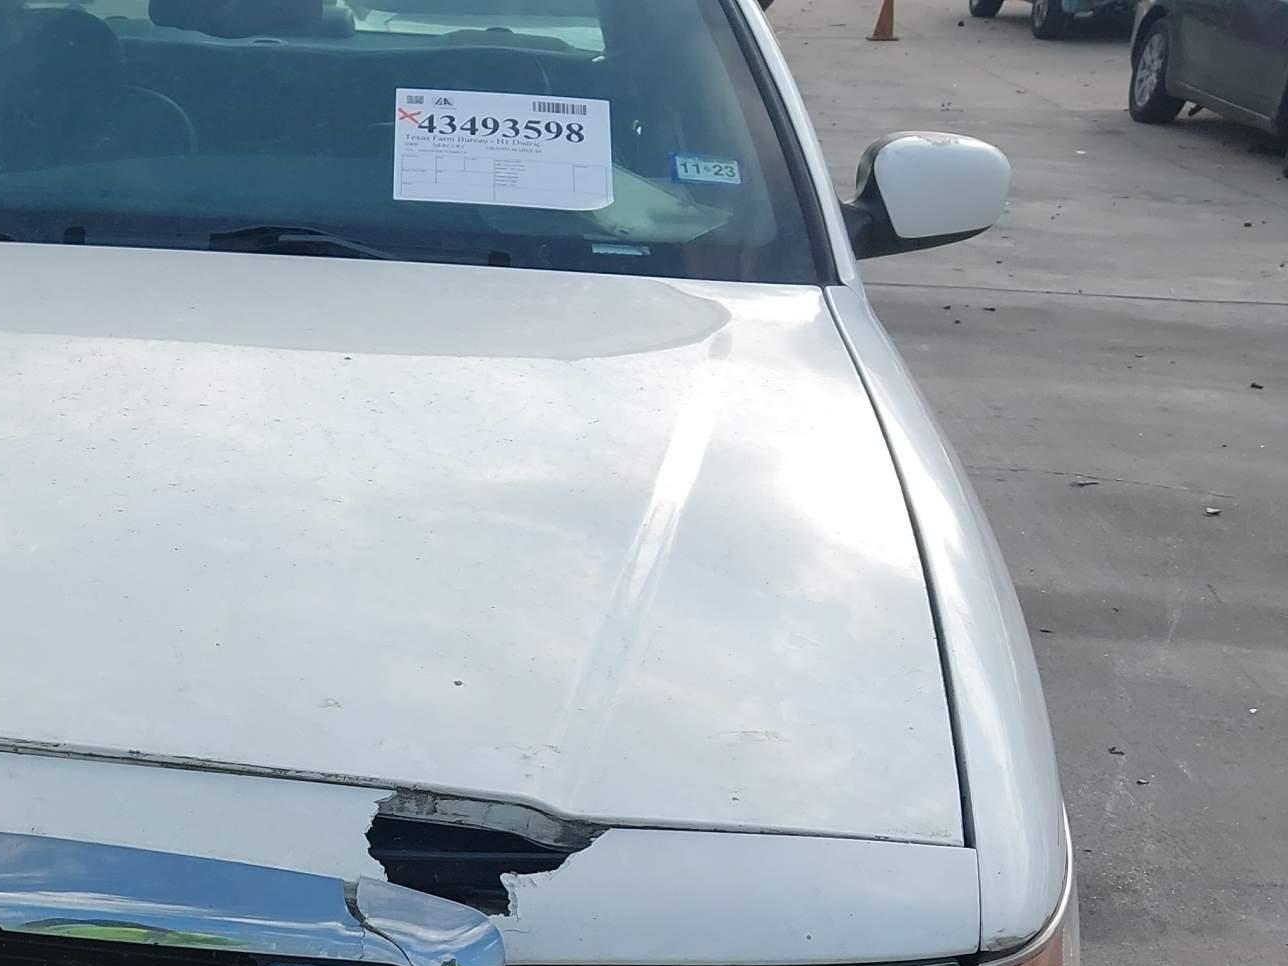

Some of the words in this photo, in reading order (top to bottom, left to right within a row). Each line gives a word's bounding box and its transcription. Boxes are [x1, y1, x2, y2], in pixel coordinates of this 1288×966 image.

[417, 113, 585, 143] 43493598
[406, 134, 430, 142] Texas
[432, 135, 456, 143] Farm
[712, 164, 736, 178] 23
